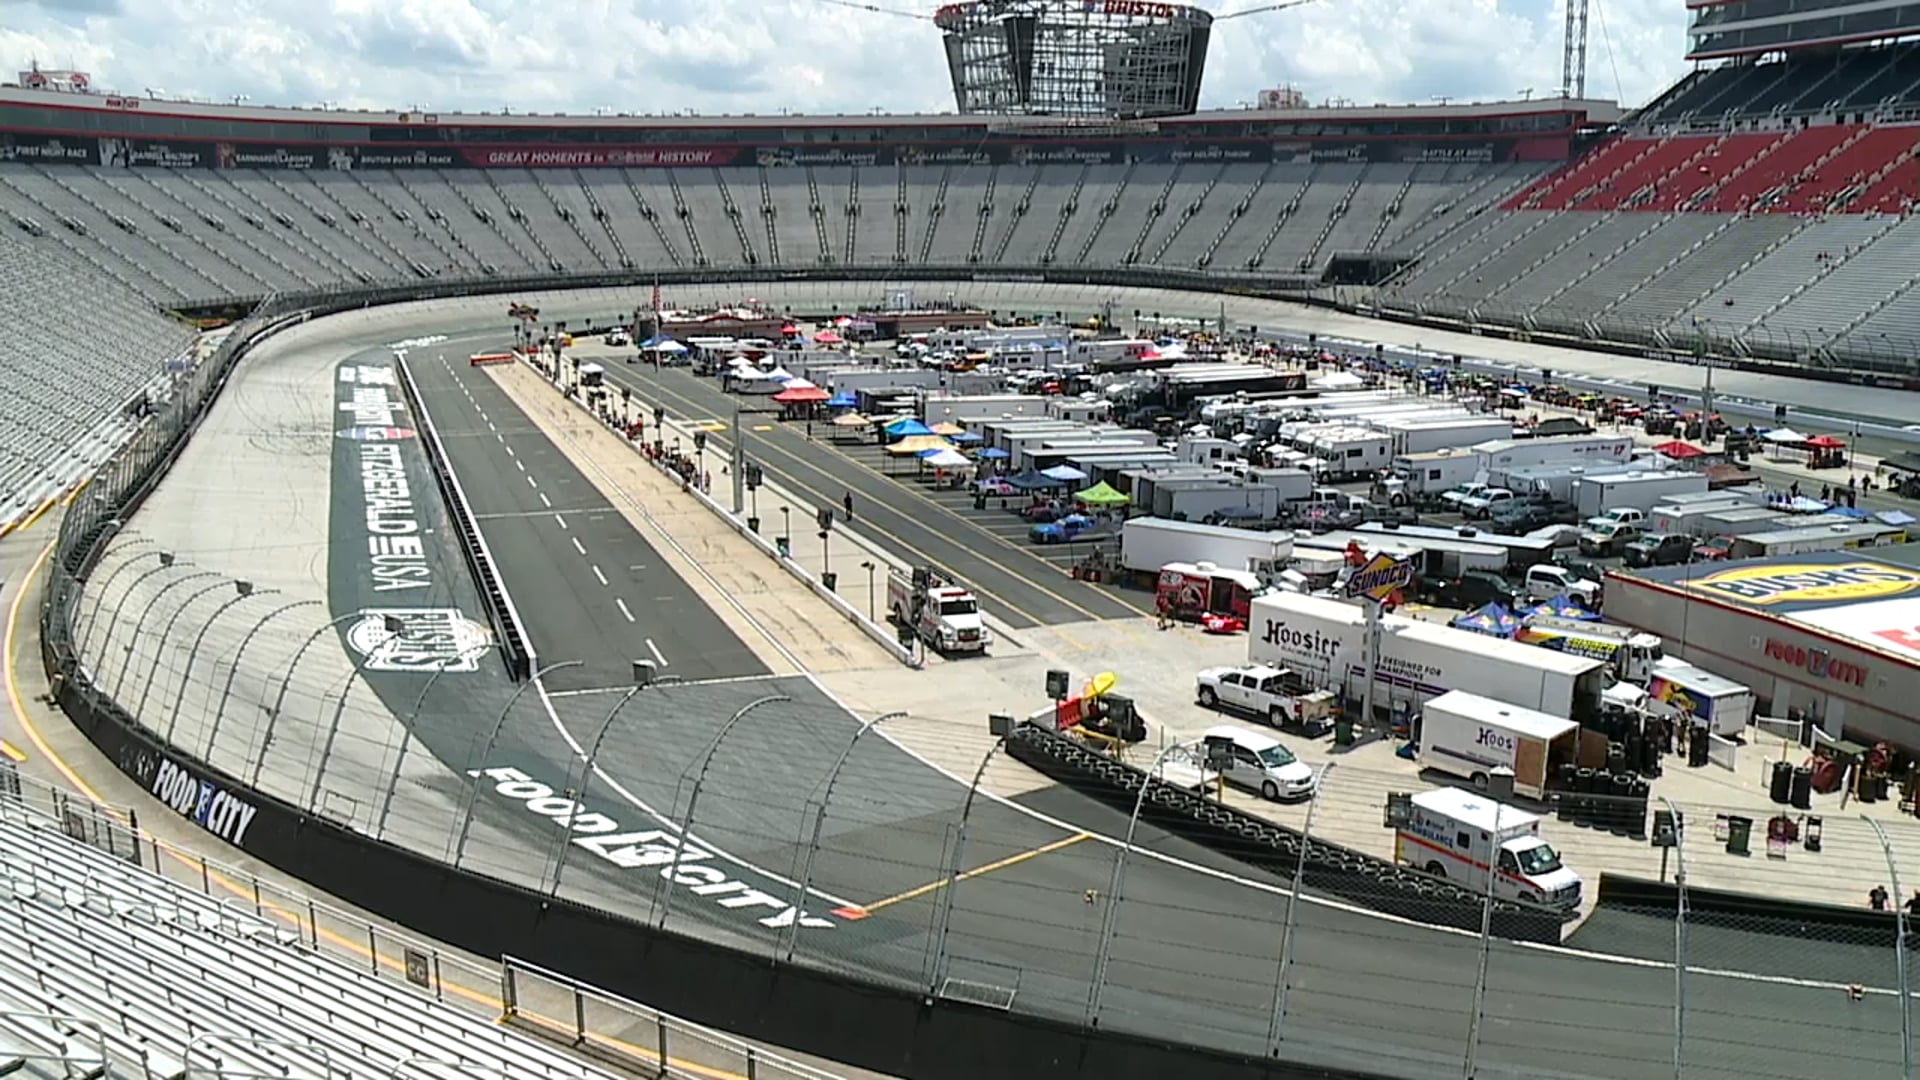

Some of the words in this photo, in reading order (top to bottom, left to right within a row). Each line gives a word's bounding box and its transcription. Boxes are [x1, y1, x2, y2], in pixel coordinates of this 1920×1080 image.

[489, 152, 529, 163] GREAT
[531, 152, 592, 163] MOMENTS
[659, 151, 712, 163] HISTORY
[360, 443, 418, 534] FITZGERALD
[371, 554, 432, 591] USA
[1351, 563, 1409, 593] SUNOCO
[1261, 618, 1341, 657] Hoosier
[1424, 665, 1441, 677] FOR
[1764, 638, 1807, 667] FOOD
[1827, 657, 1870, 688] CITY
[152, 758, 198, 815] FOOD
[207, 790, 257, 845] CITY
[467, 767, 618, 833] FOOD
[660, 864, 836, 928] CITY
